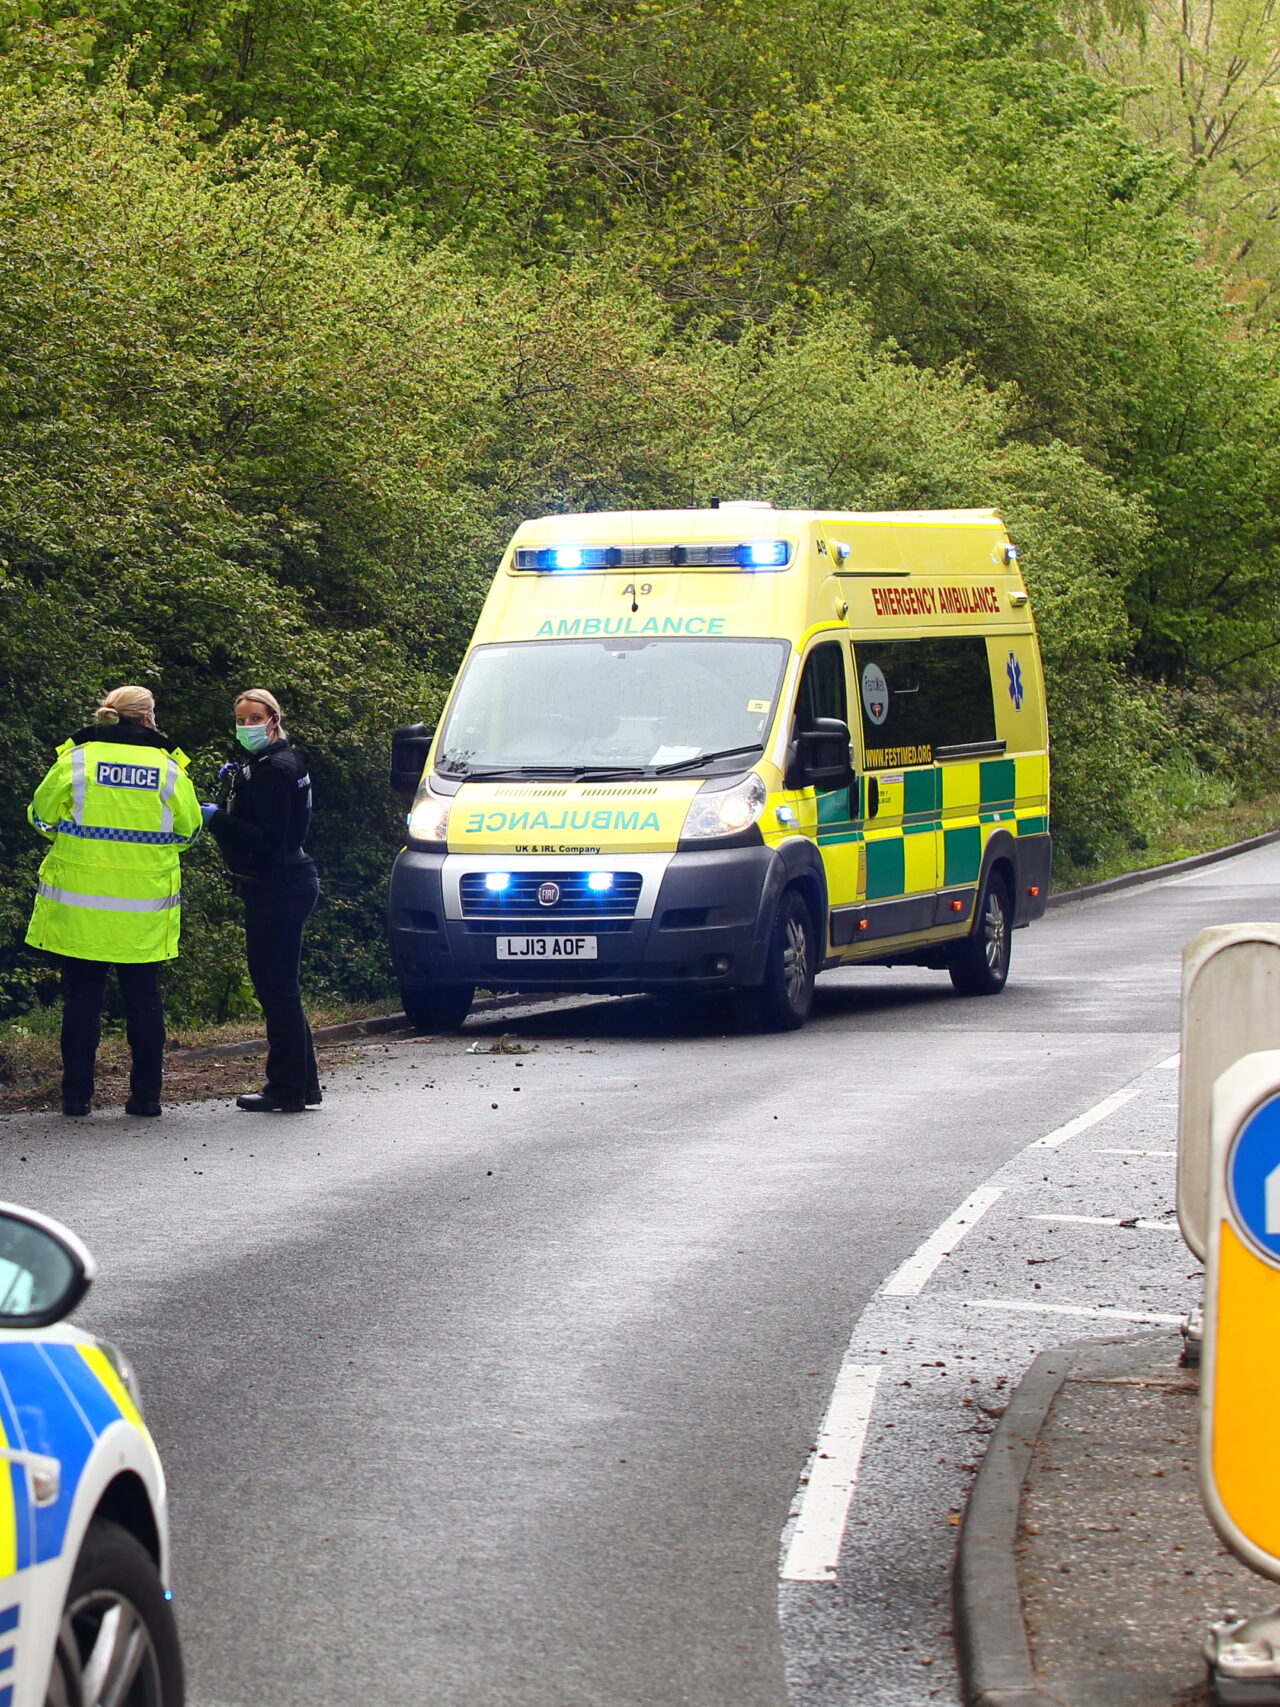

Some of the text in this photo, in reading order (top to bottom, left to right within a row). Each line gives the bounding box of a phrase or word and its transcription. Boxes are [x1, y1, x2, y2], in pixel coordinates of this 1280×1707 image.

[621, 583, 652, 596] A9
[871, 587, 1000, 616] EMERGENCY AMBULANCE
[536, 616, 726, 637] AMBULANCE
[866, 745, 932, 768] WWW.FESTIMED.ORG
[99, 766, 157, 786] POLICE
[515, 845, 601, 855] UK & IRL Company
[541, 889, 555, 901] FIAT
[507, 938, 585, 956] LJ13 AOF
